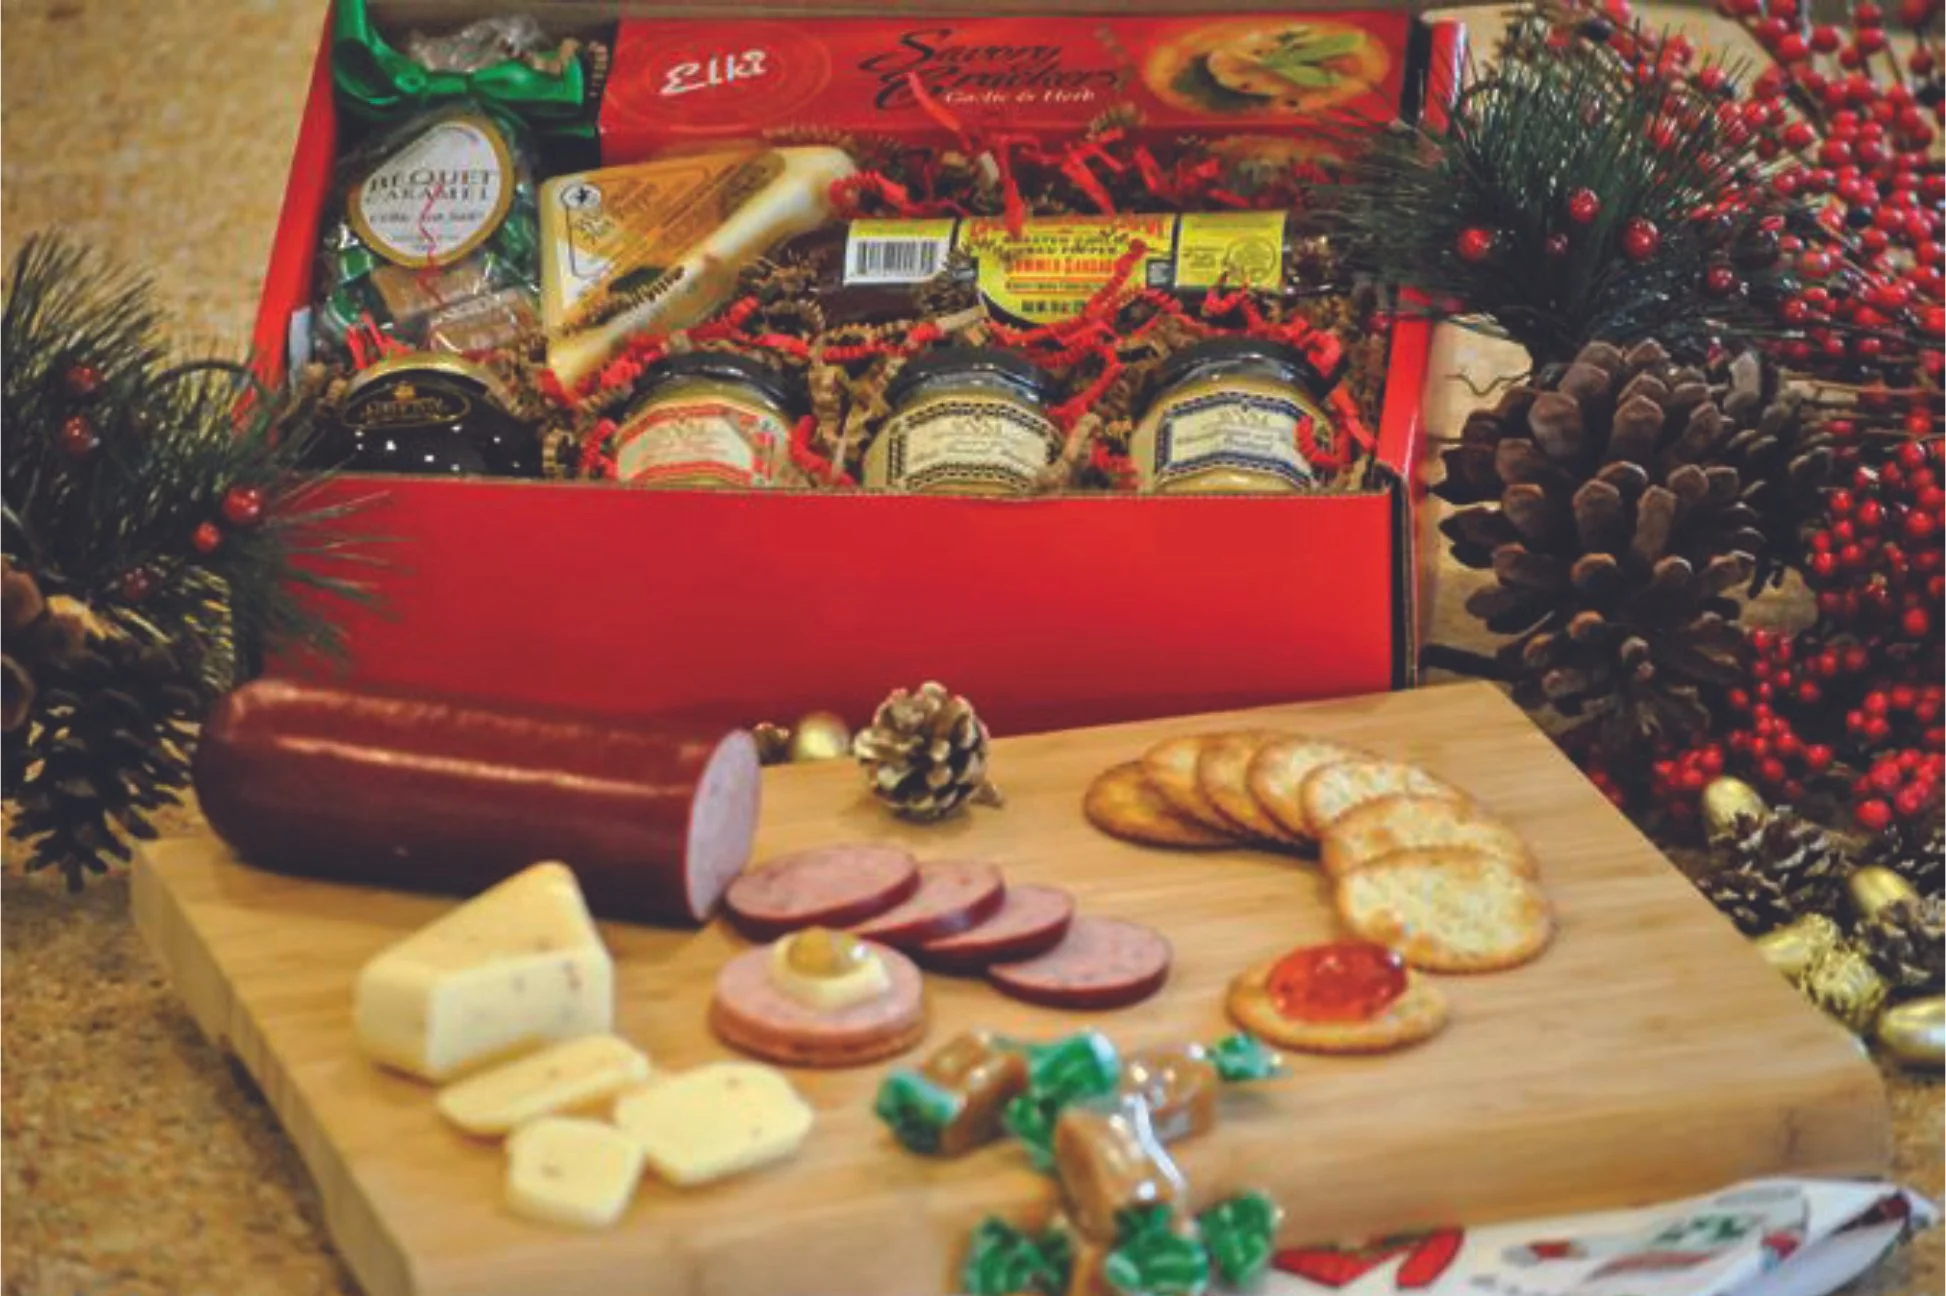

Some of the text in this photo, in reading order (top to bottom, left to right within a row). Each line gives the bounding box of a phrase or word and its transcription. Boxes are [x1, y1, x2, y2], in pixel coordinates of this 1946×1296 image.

[859, 28, 1062, 70] Savory
[659, 49, 767, 96] Elki
[944, 88, 1096, 104] Garlic & Herb
[1006, 257, 1117, 274] UMMER SAUSAG
